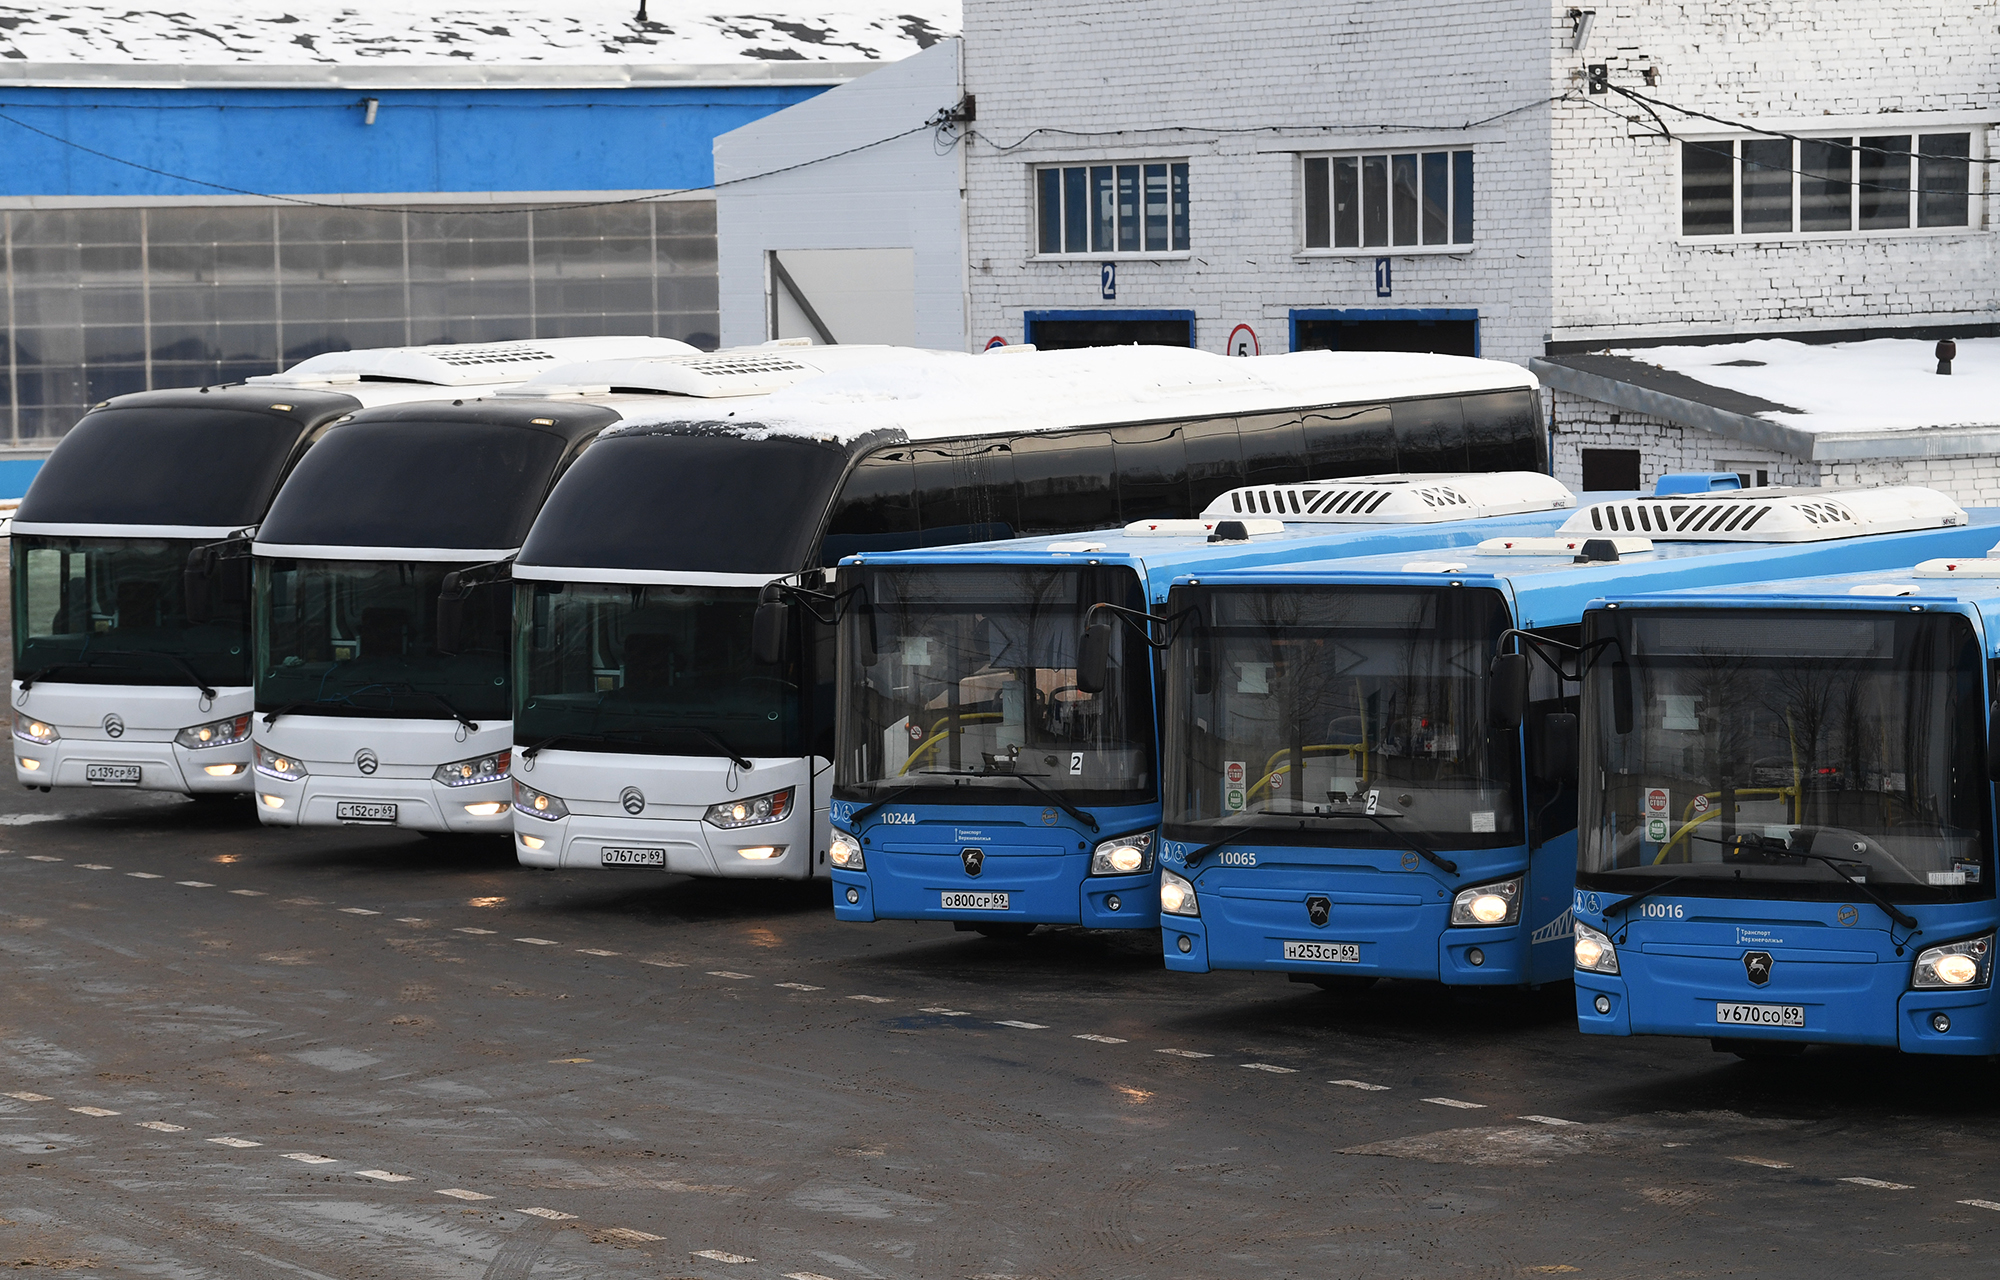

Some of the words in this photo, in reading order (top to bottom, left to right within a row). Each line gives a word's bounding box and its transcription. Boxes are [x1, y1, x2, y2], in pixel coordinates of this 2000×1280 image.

[1103, 265, 1114, 295] 2
[1378, 261, 1390, 293] 1
[1238, 343, 1247, 357] 5
[1071, 755, 1081, 771] 2
[382, 806, 393, 815] 69
[1367, 795, 1377, 811] 2
[881, 812, 916, 825] 10244
[605, 850, 647, 863] О767СР
[649, 851, 660, 860] 69
[1218, 851, 1256, 866] 10065
[945, 894, 991, 908] О800СР
[993, 894, 1005, 904] 69
[1640, 903, 1684, 919] 10016
[1288, 944, 1339, 960] Н253СР
[1342, 945, 1355, 957] 69
[1722, 1005, 1781, 1023] У670СО
[1783, 1007, 1799, 1020] 69
